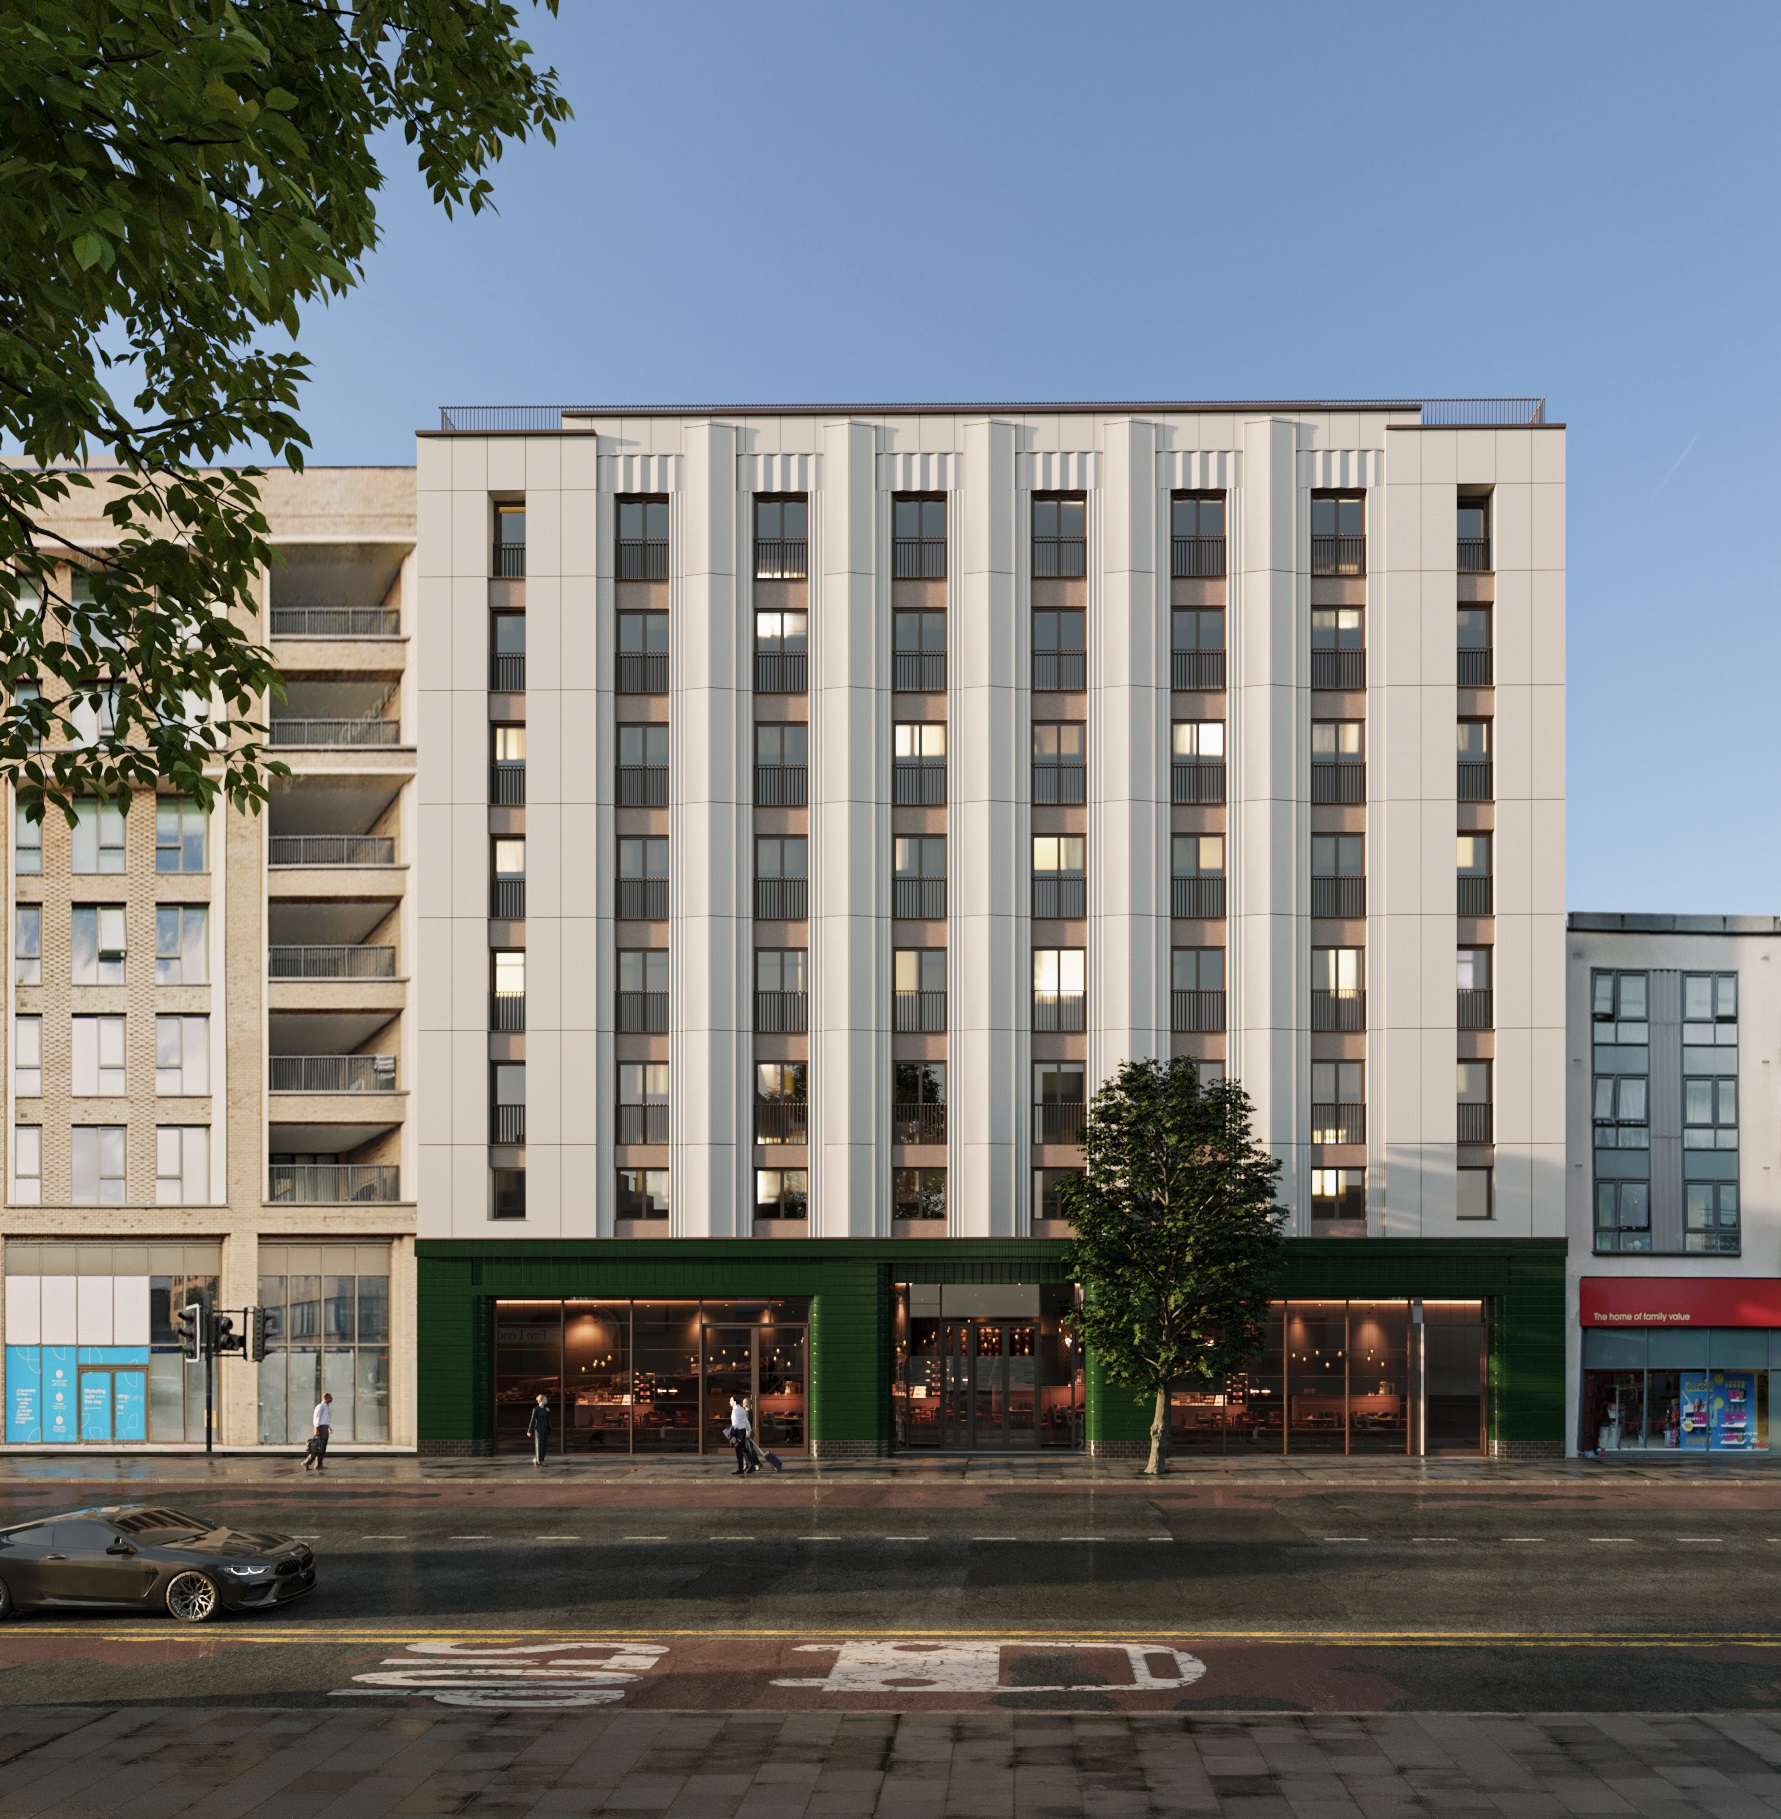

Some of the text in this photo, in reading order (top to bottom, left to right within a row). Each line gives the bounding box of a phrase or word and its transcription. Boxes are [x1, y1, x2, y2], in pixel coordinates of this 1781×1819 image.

[1593, 1312, 1690, 1322] The home of family value
[326, 1641, 670, 1708] STOP
